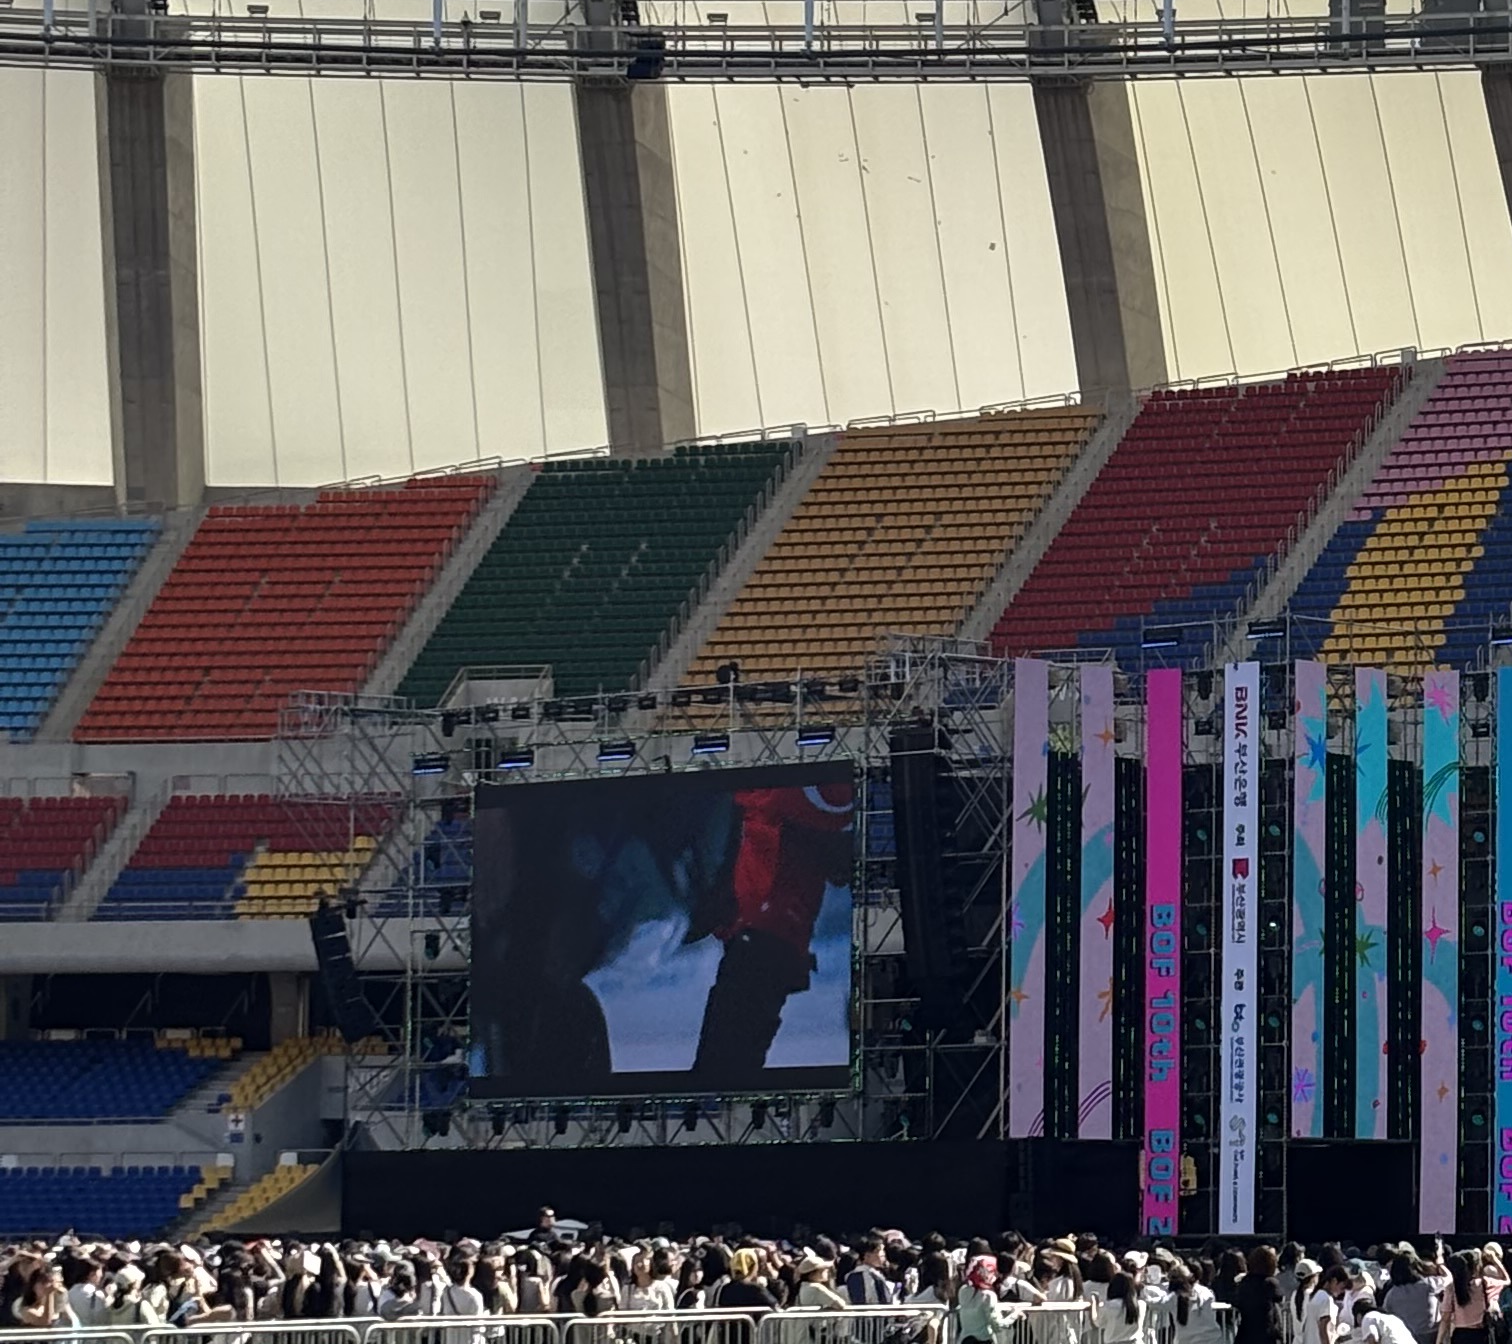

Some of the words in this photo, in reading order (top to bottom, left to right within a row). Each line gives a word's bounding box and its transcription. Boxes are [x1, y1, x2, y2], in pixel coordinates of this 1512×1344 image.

[1149, 904, 1175, 977] BOF
[1148, 989, 1175, 1082] 10th
[1148, 1129, 1174, 1204] BOF
